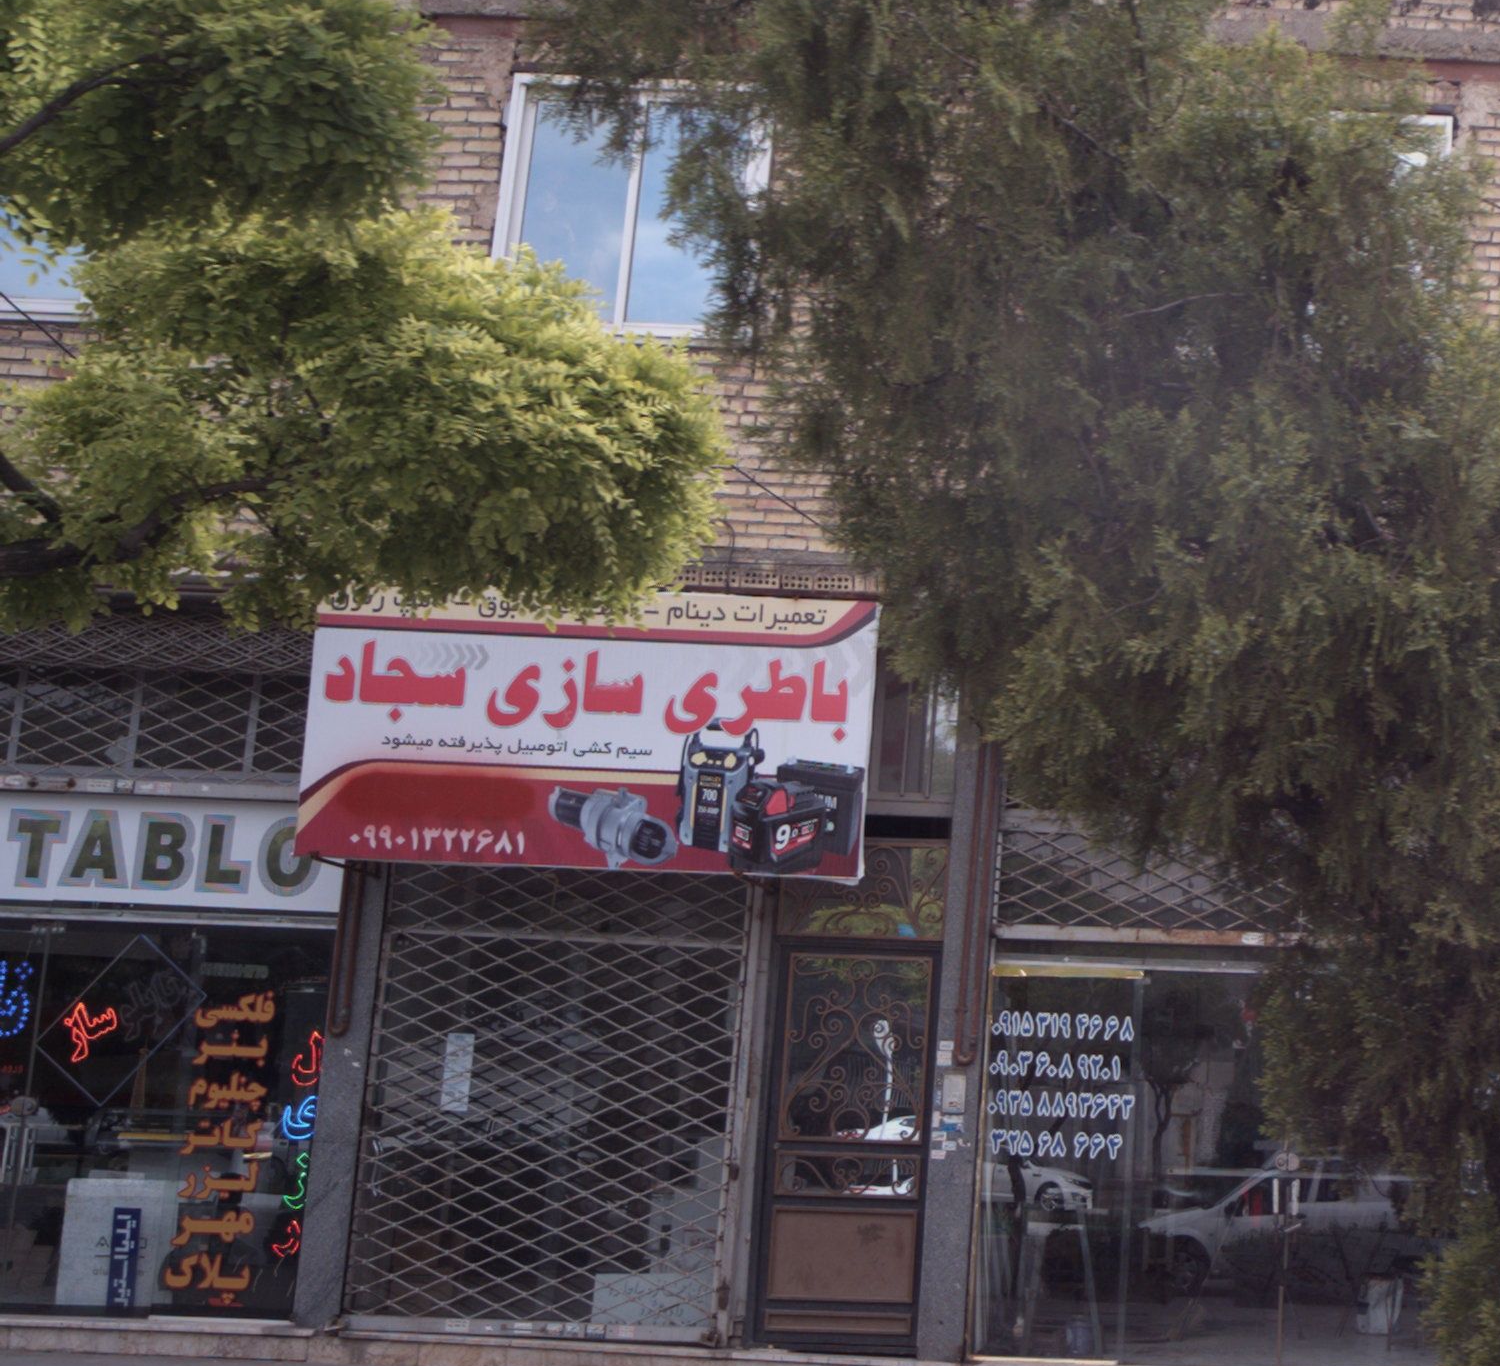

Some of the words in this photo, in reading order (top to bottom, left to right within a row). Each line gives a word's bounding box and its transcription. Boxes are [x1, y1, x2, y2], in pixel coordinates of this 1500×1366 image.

[666, 599, 726, 628] دینام
[733, 603, 828, 631] تعمیرات
[323, 638, 467, 723] سجاد
[486, 649, 645, 730] سازی
[664, 656, 849, 743] باطری
[380, 732, 434, 751] میشود
[437, 735, 503, 755] پذیرفته
[507, 738, 568, 756] اتومبیل
[572, 741, 612, 759] کشی
[616, 744, 653, 760] سیم
[7, 808, 322, 897] TABLO
[349, 823, 526, 856] ۰۹۹۰۱۳۲۲۶۸۱
[194, 989, 277, 1029] فلکسی
[170, 1210, 255, 1247] مهر
